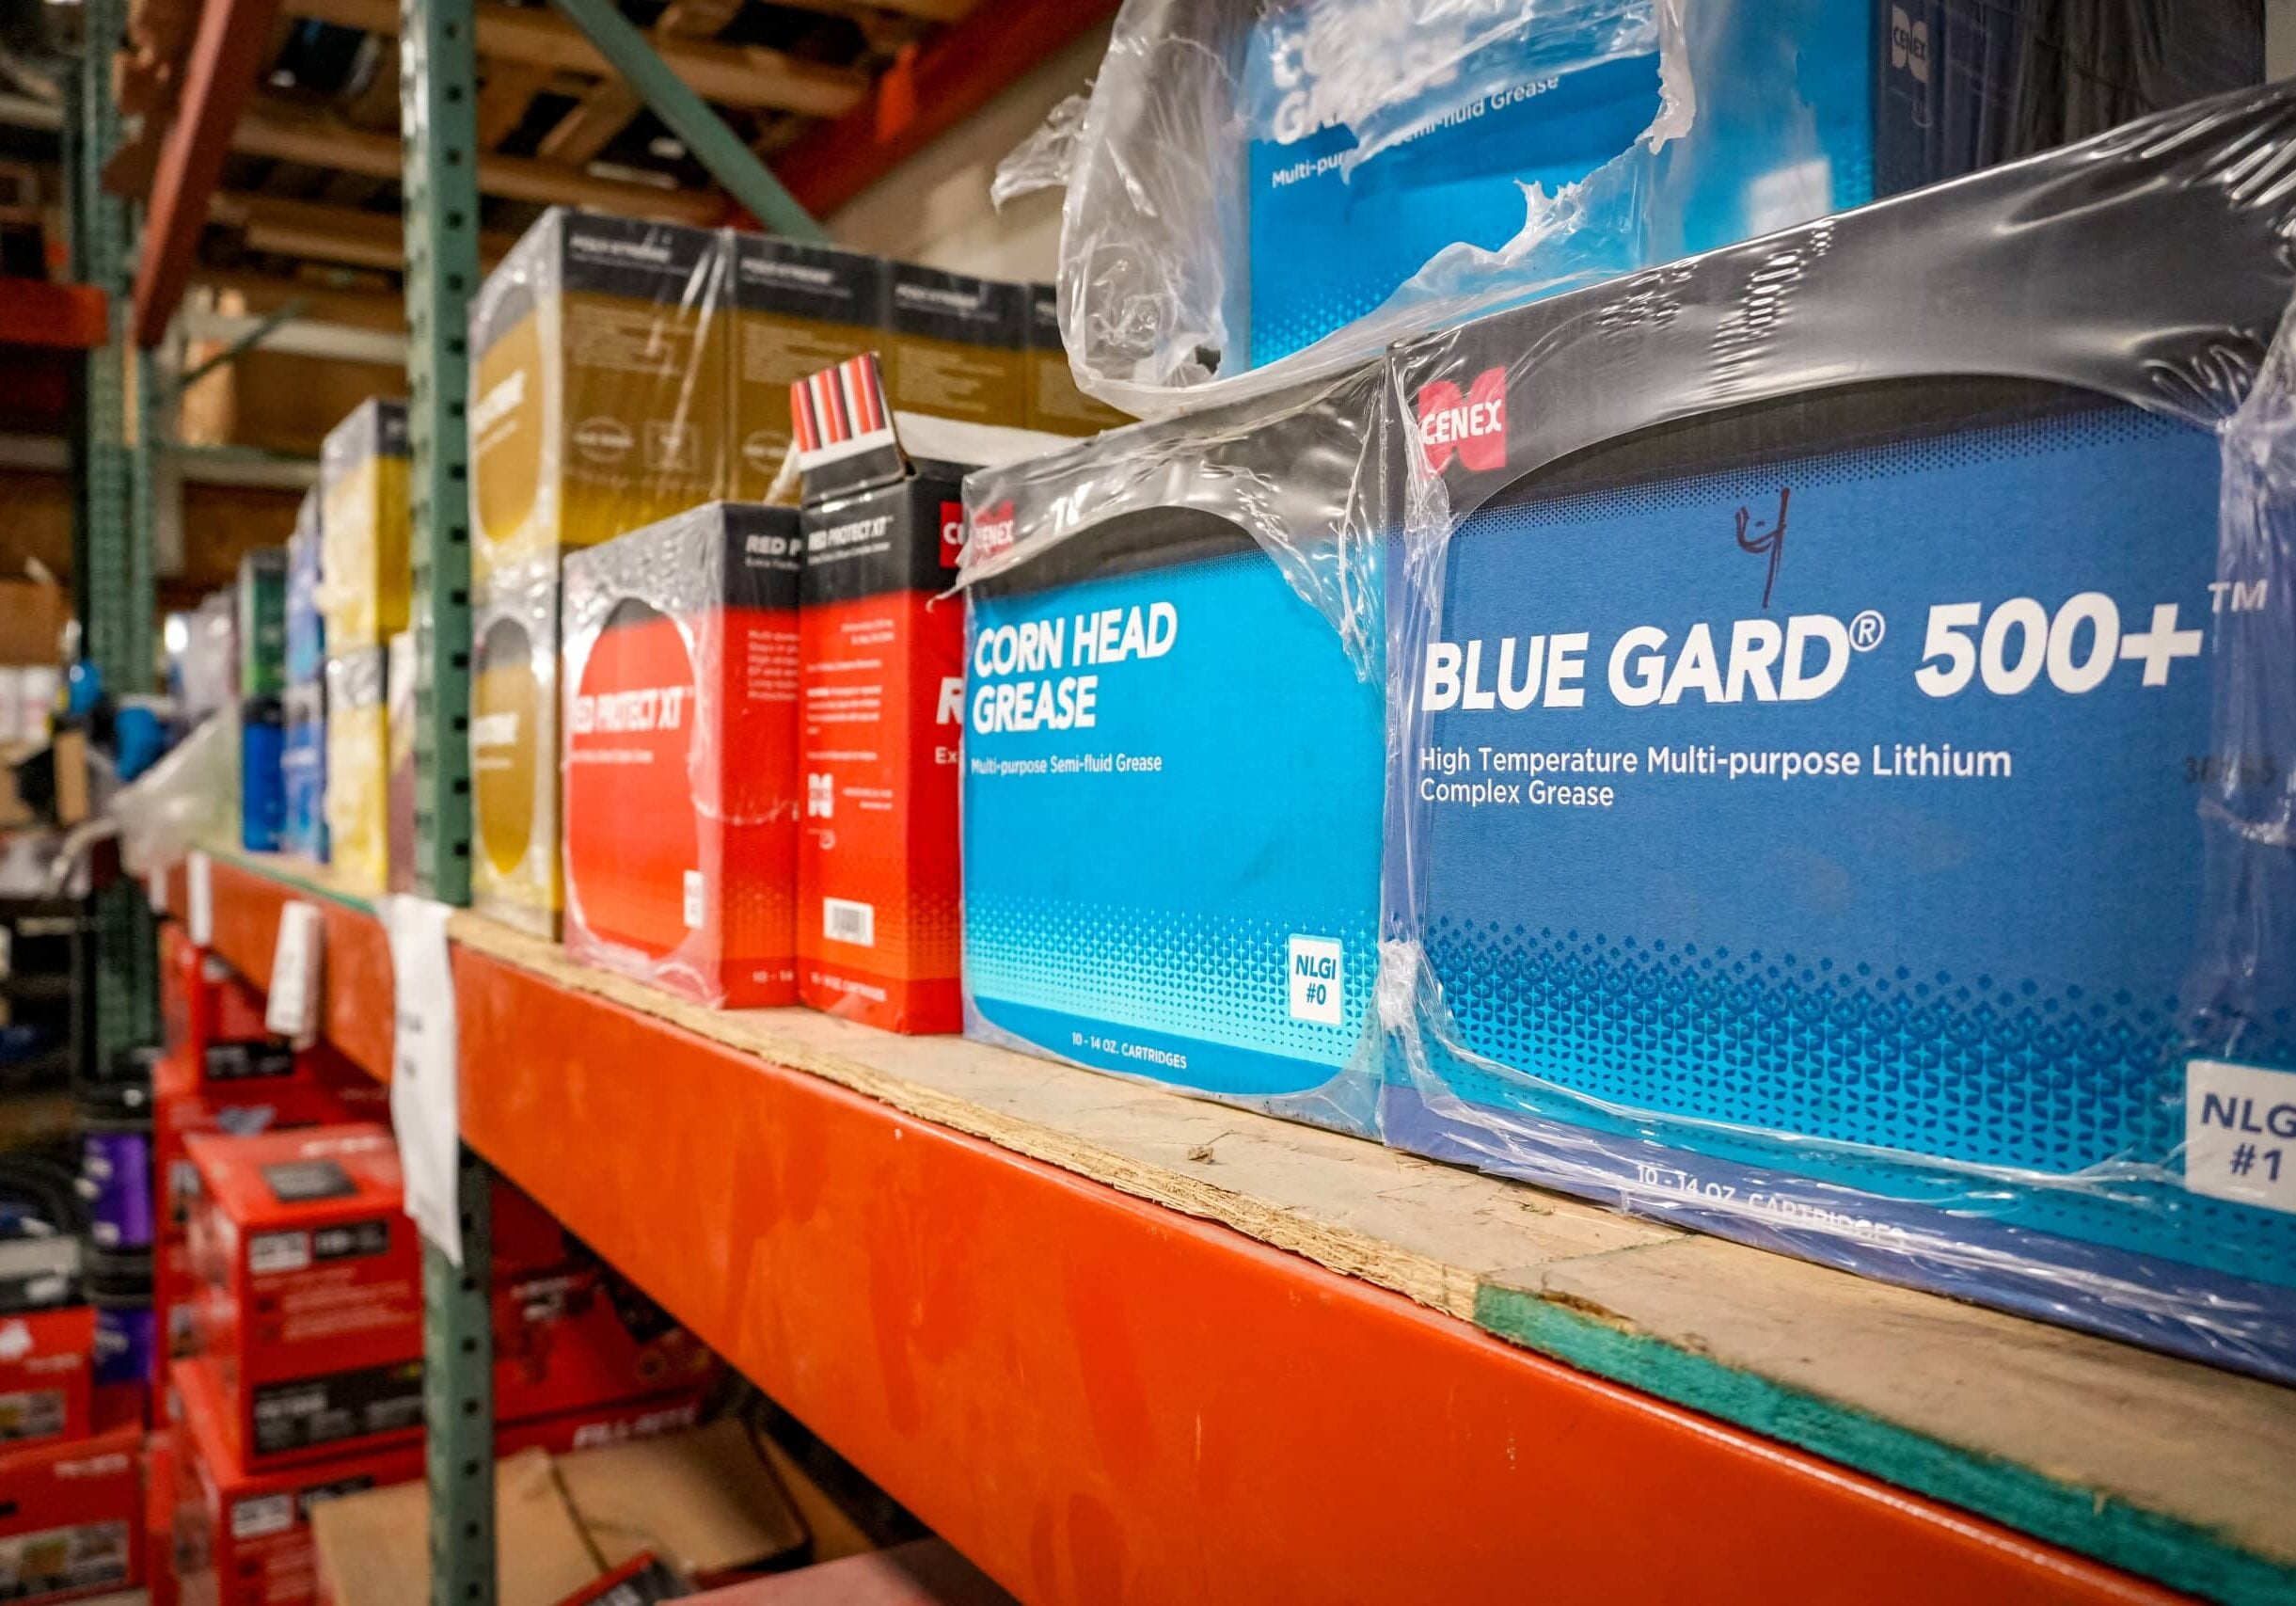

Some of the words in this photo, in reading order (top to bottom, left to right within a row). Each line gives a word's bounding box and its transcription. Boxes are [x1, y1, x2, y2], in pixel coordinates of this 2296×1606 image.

[1490, 77, 1559, 110] Grease
[1421, 399, 1501, 445] CENEX
[745, 533, 786, 555] RED
[1735, 487, 1789, 609] 4
[974, 617, 1065, 677] CORN
[1072, 602, 1178, 665] HEAD
[1421, 631, 1590, 711] BLUE
[973, 676, 1099, 734] GREASE
[972, 756, 1047, 776] Multi-purpose
[1050, 754, 1112, 772] Semi-fluid
[1116, 753, 1163, 772] Grease
[1420, 748, 1470, 775] High
[1479, 747, 1639, 776] Temperature
[1647, 744, 1861, 780] Multi-purpose
[1872, 741, 2012, 778] Lithium
[1420, 778, 1521, 806] Complex
[1528, 780, 1614, 806] Grease
[1295, 953, 1337, 981] NLGI
[1306, 983, 1327, 1006] #0
[1072, 1031, 1083, 1045] 10
[1090, 1036, 1100, 1049] 14
[1121, 1042, 1187, 1069] CARTRIDGES
[1638, 1164, 1657, 1185] 10
[2230, 1142, 2284, 1184] #1
